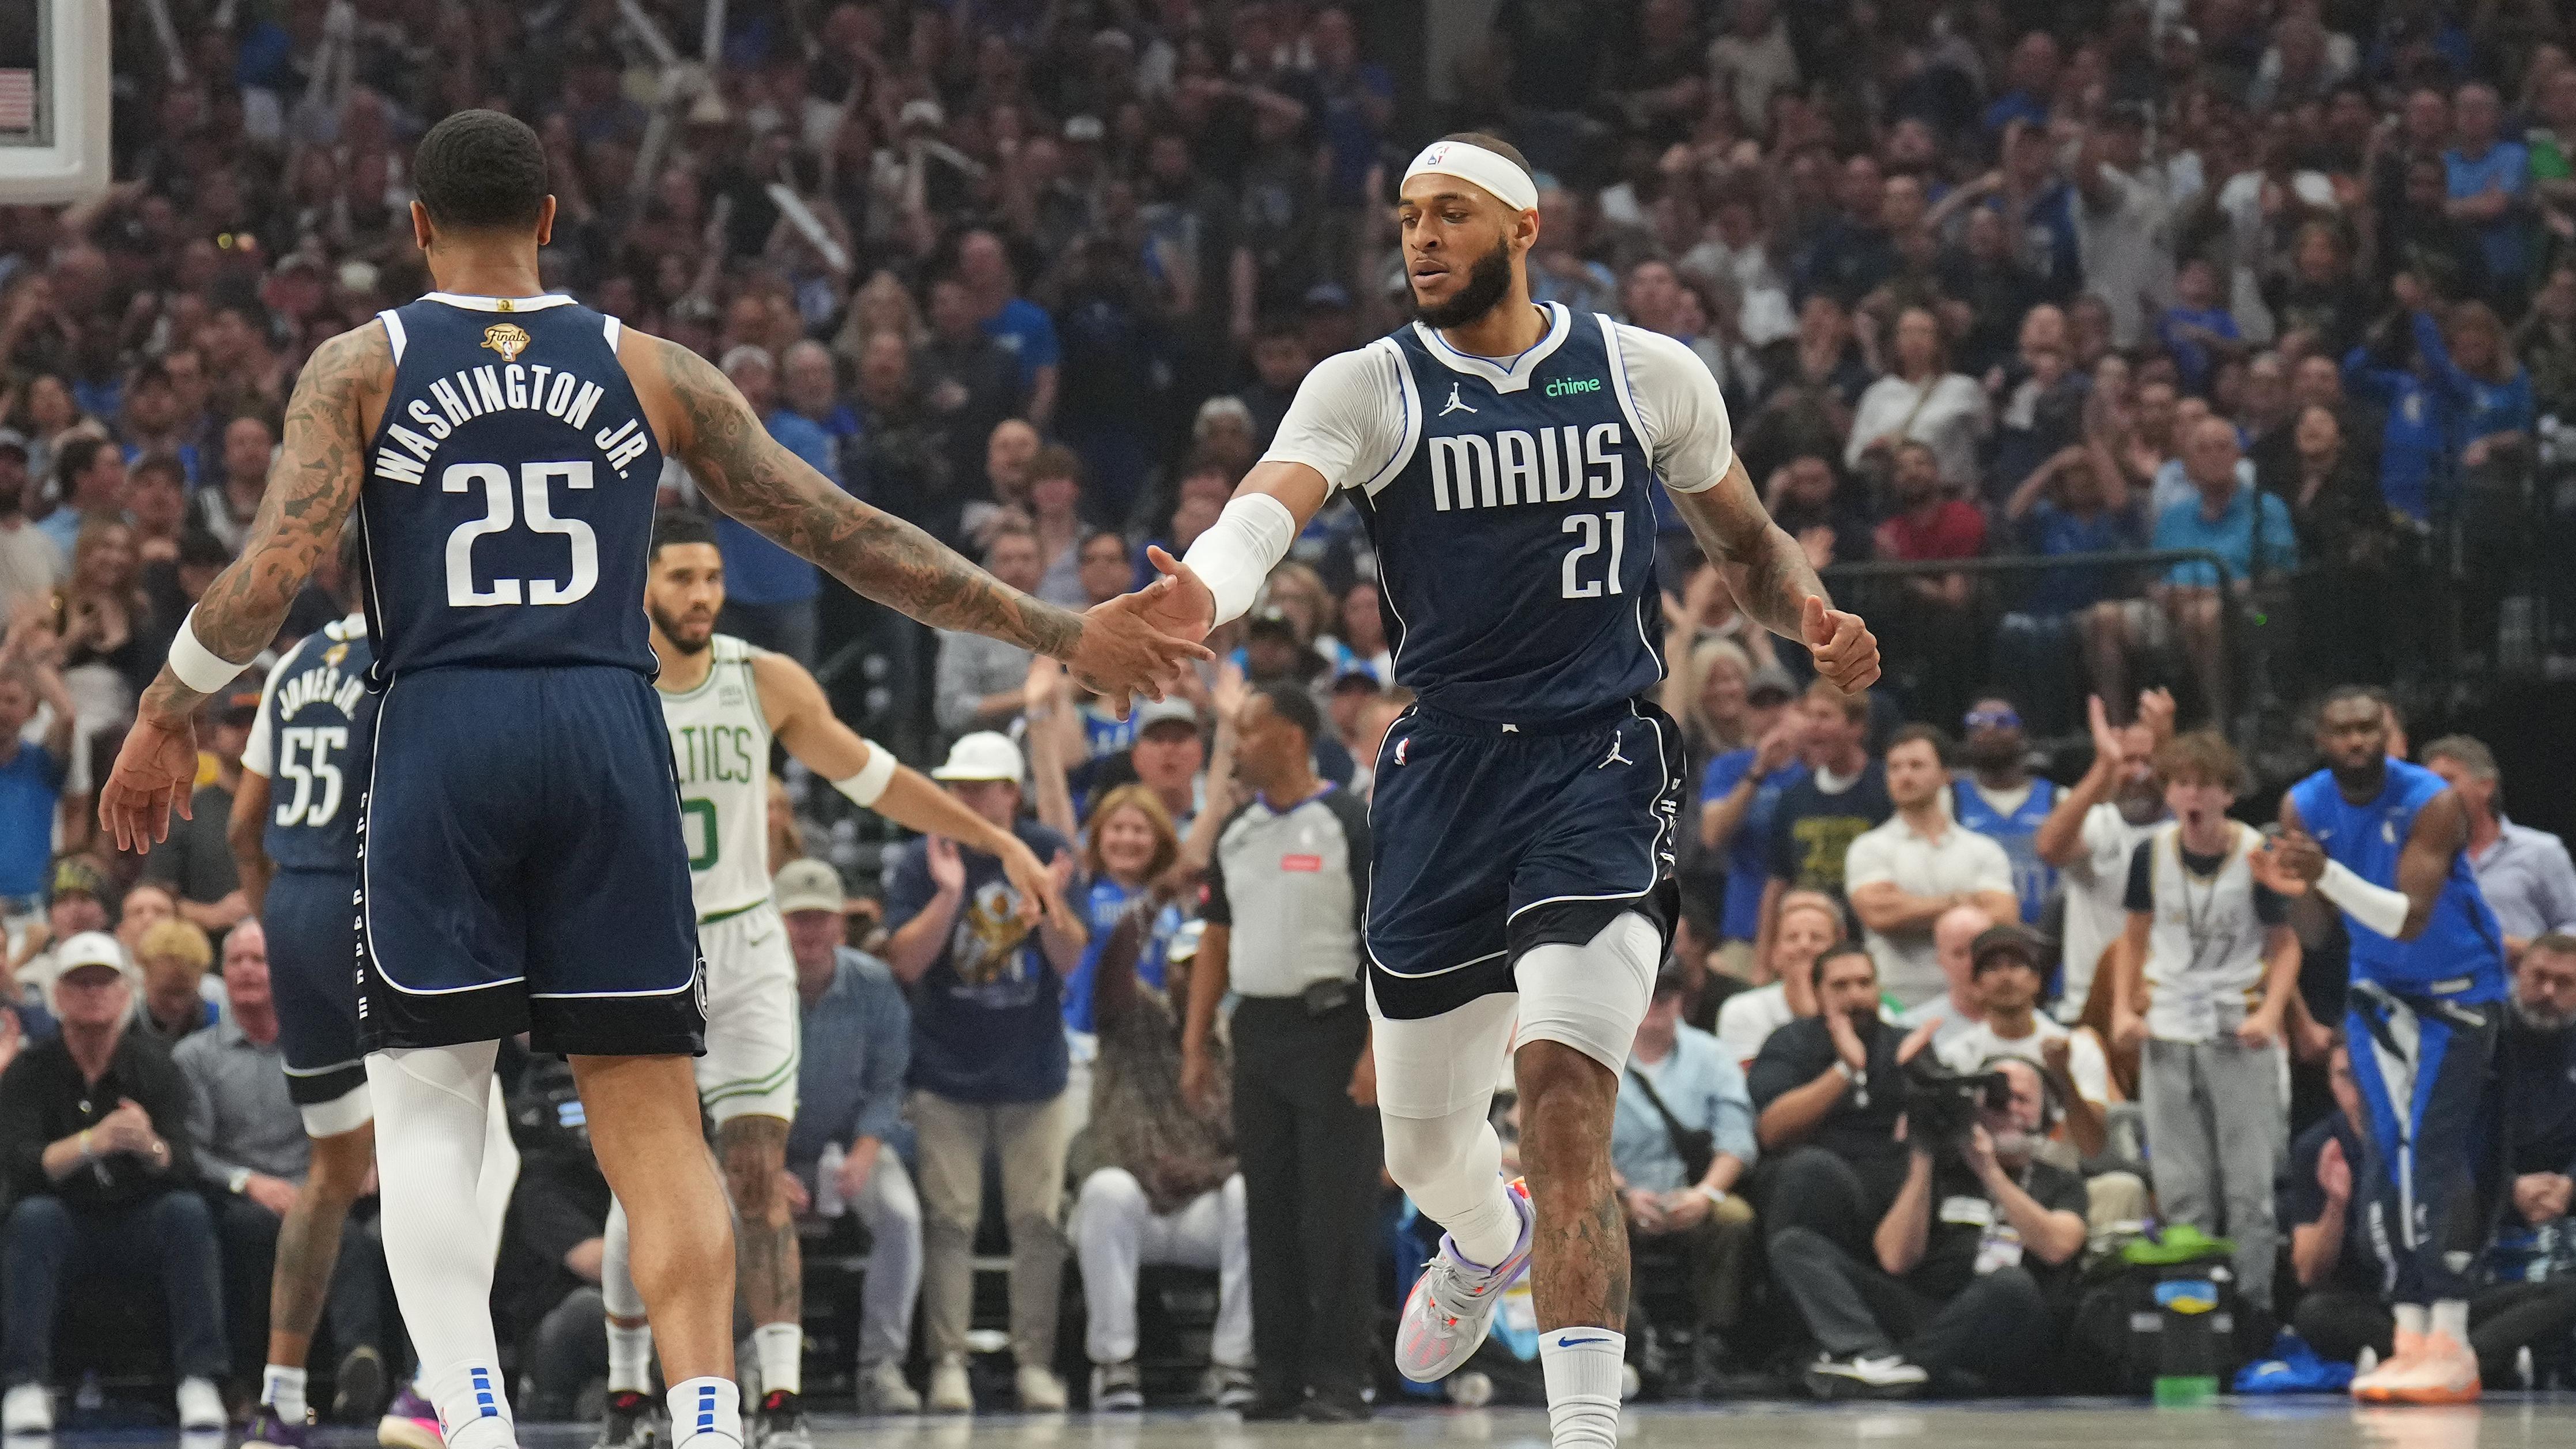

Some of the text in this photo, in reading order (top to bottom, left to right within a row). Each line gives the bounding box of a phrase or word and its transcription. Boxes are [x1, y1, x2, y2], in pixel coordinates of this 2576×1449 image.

[482, 329, 527, 346] Finals
[375, 364, 649, 485] WASHINGTON JR.
[1546, 377, 1601, 397] chime
[1429, 422, 1624, 511] MAVS
[442, 461, 599, 607] 25
[1562, 511, 1625, 599] 21
[276, 726, 348, 827] 55
[679, 724, 752, 784] TICS
